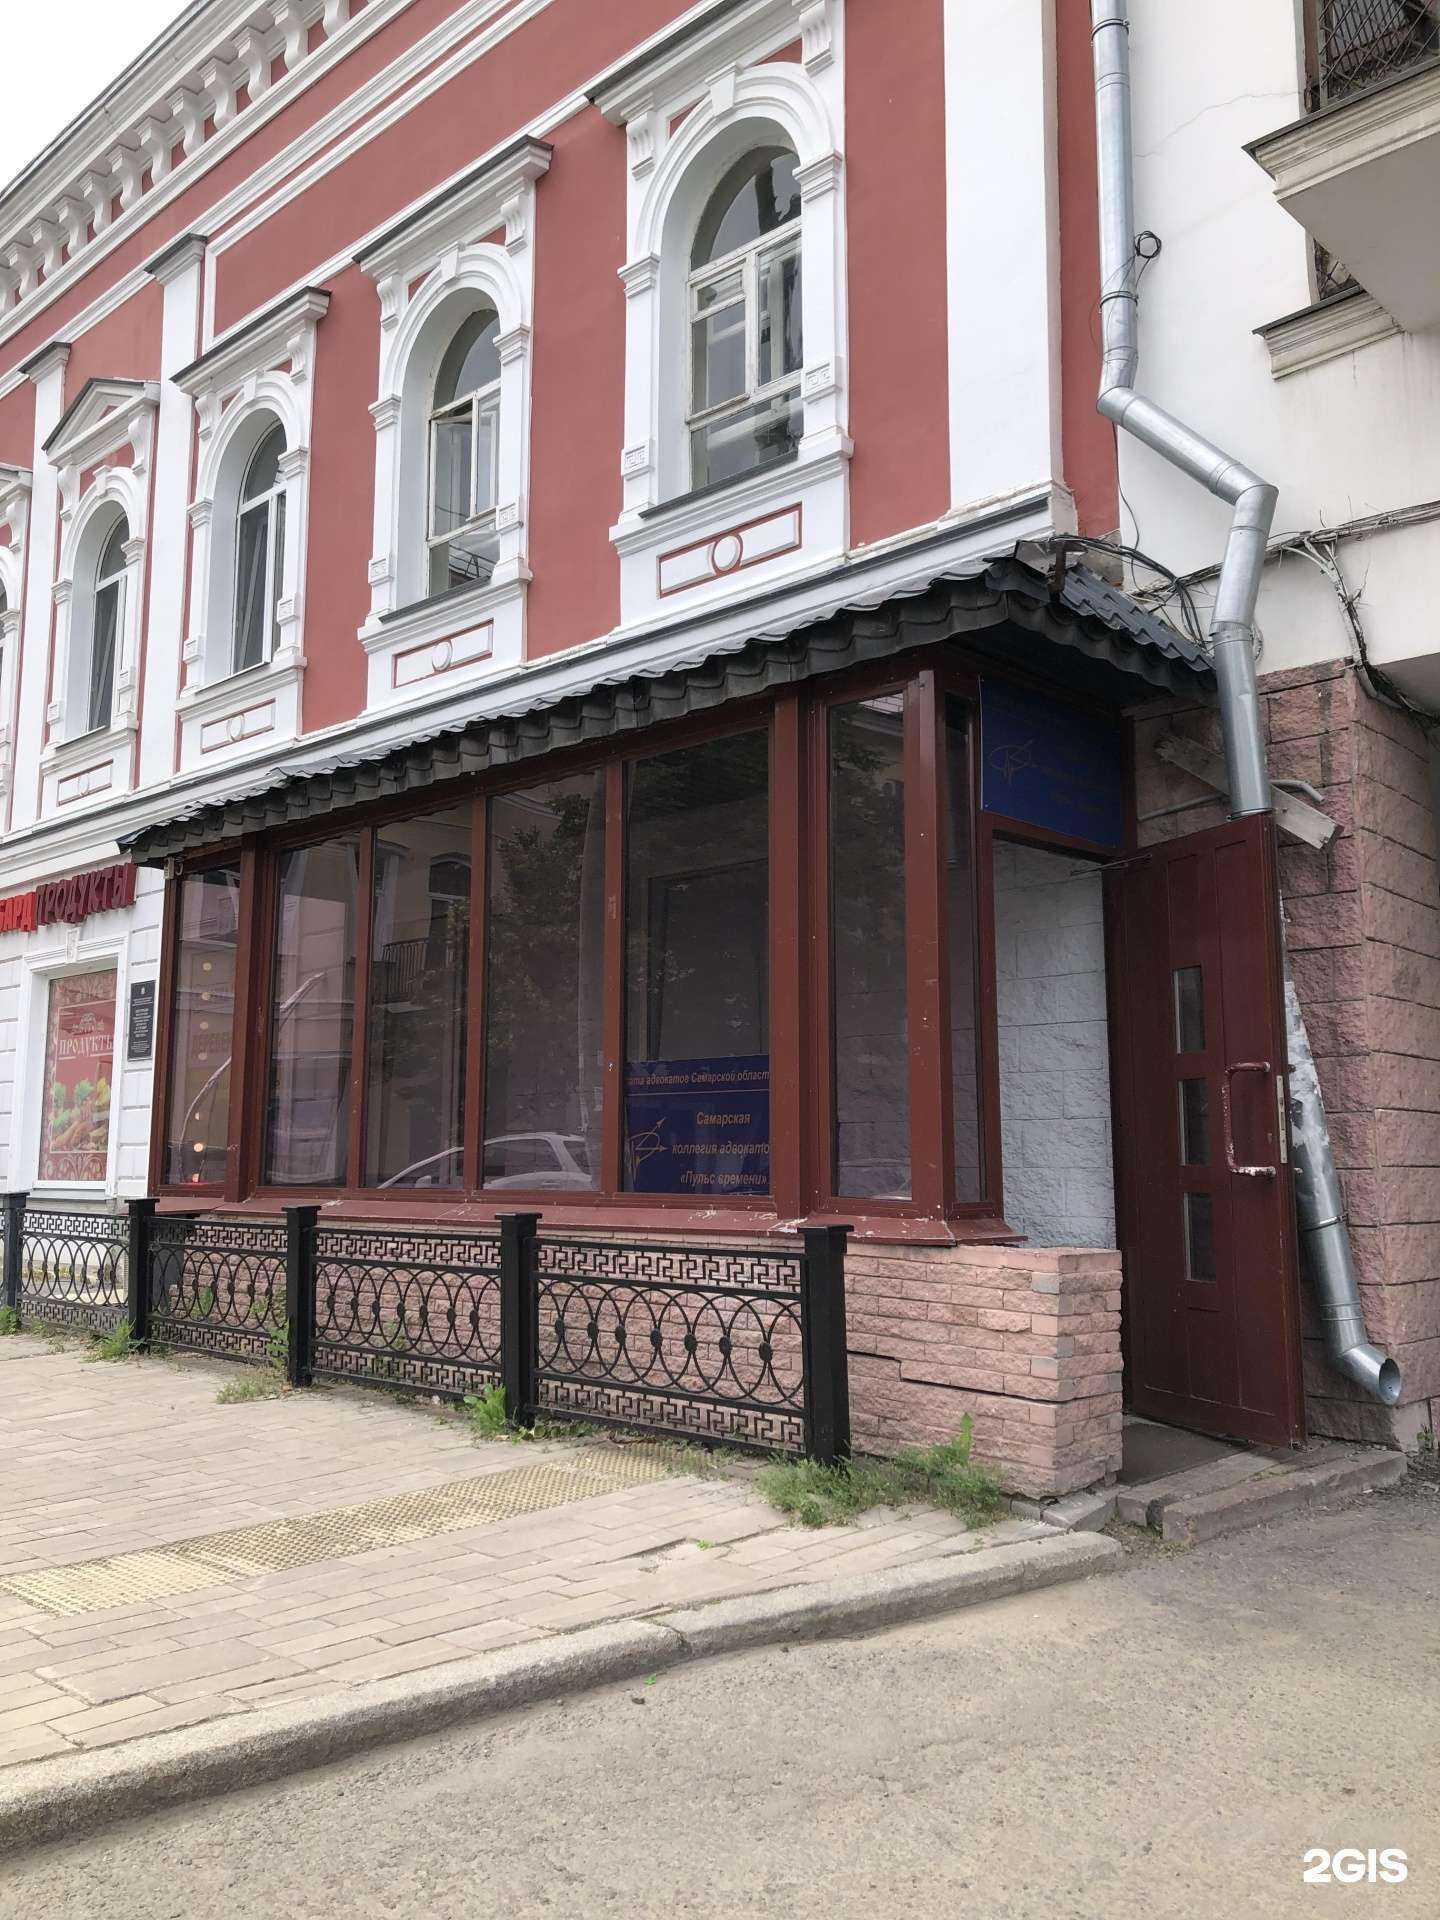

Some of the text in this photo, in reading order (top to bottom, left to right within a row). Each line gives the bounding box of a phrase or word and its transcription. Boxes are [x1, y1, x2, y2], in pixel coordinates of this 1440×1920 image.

[36, 862, 137, 926] ПРОДУКТЫ
[691, 1070, 736, 1085] Самарской
[696, 1112, 751, 1127] Самарская
[672, 1143, 718, 1154] коллегия
[718, 1174, 767, 1188] времени»
